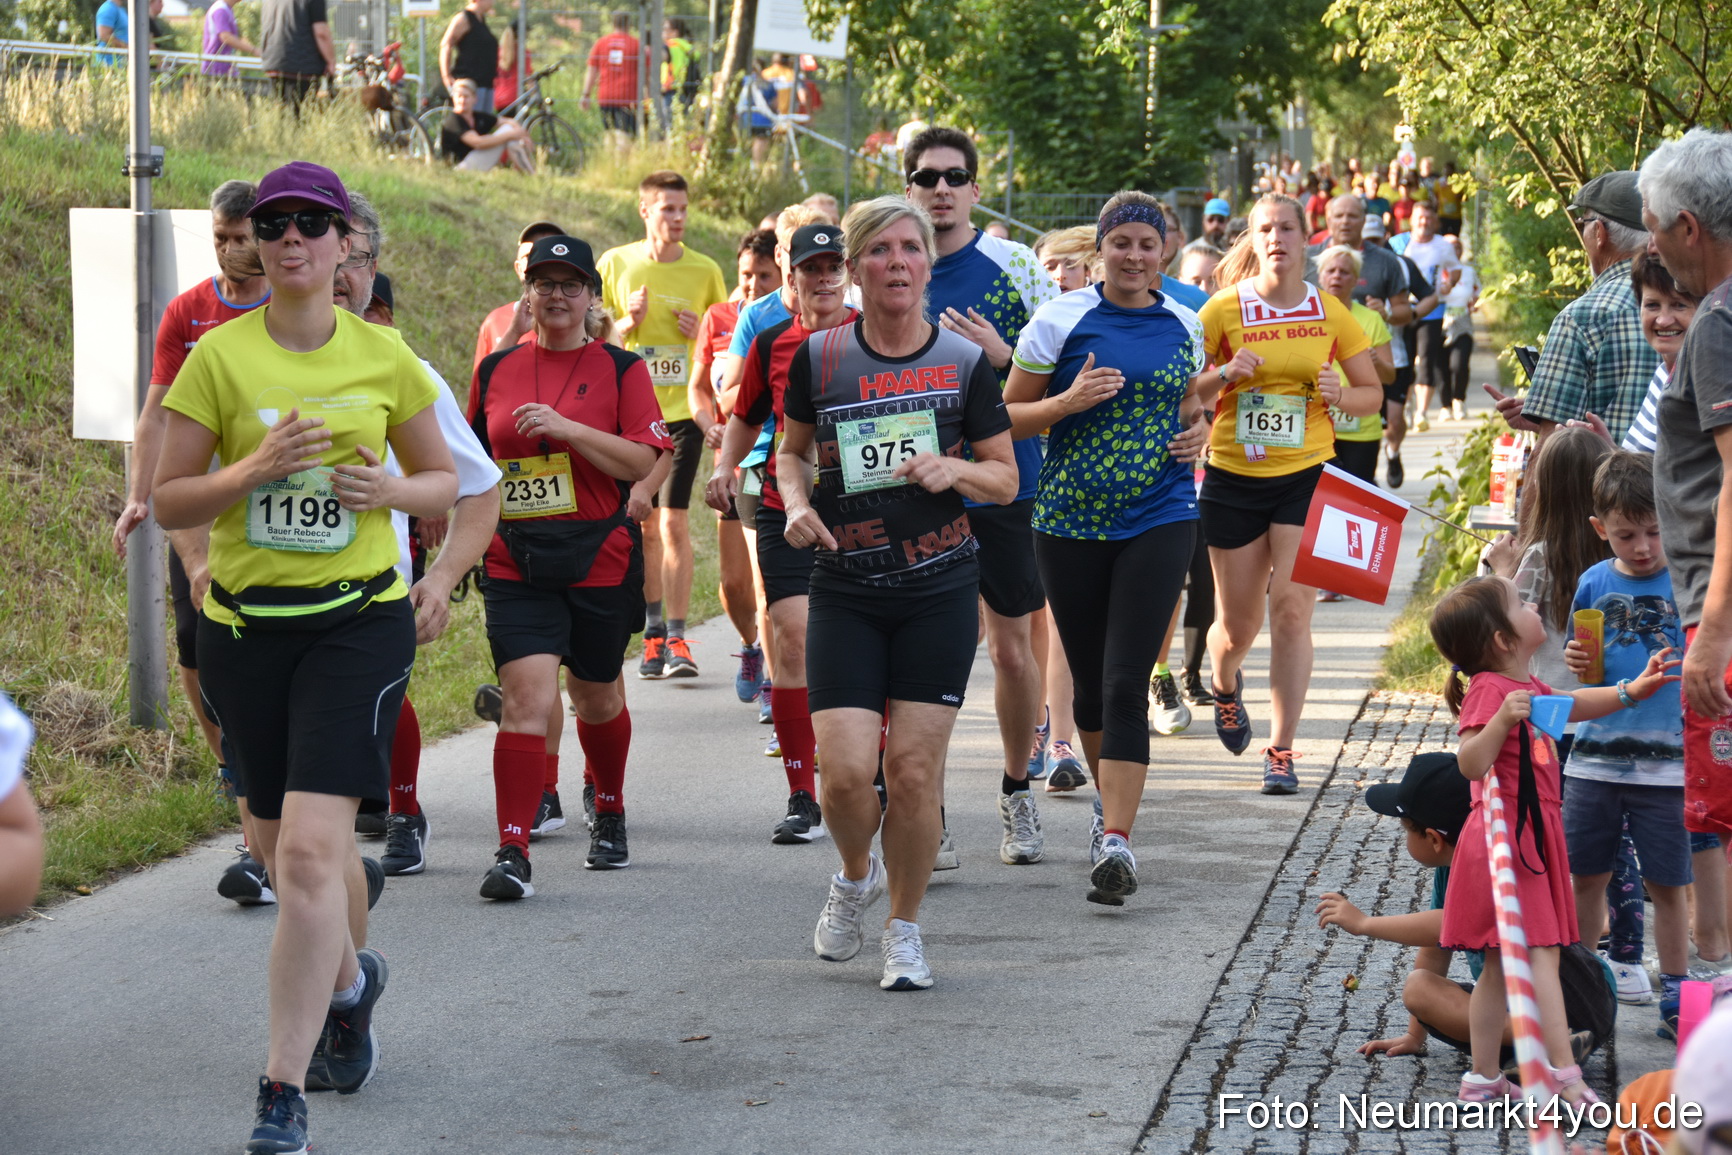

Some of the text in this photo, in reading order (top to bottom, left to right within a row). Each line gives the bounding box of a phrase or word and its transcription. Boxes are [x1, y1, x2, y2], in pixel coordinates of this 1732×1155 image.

[1243, 325, 1327, 343] MAX BÖGL
[644, 359, 682, 375] 196
[859, 364, 960, 401] HAARE
[1245, 411, 1294, 433] 1631
[861, 438, 917, 470] 975
[504, 475, 560, 502] 2331
[259, 494, 341, 528] 1198
[267, 526, 331, 538] Bauer Rebecca
[271, 535, 296, 543] Klinikum
[831, 518, 890, 550] ARE
[902, 512, 971, 566] HAAR
[1371, 552, 1381, 573] DEHN
